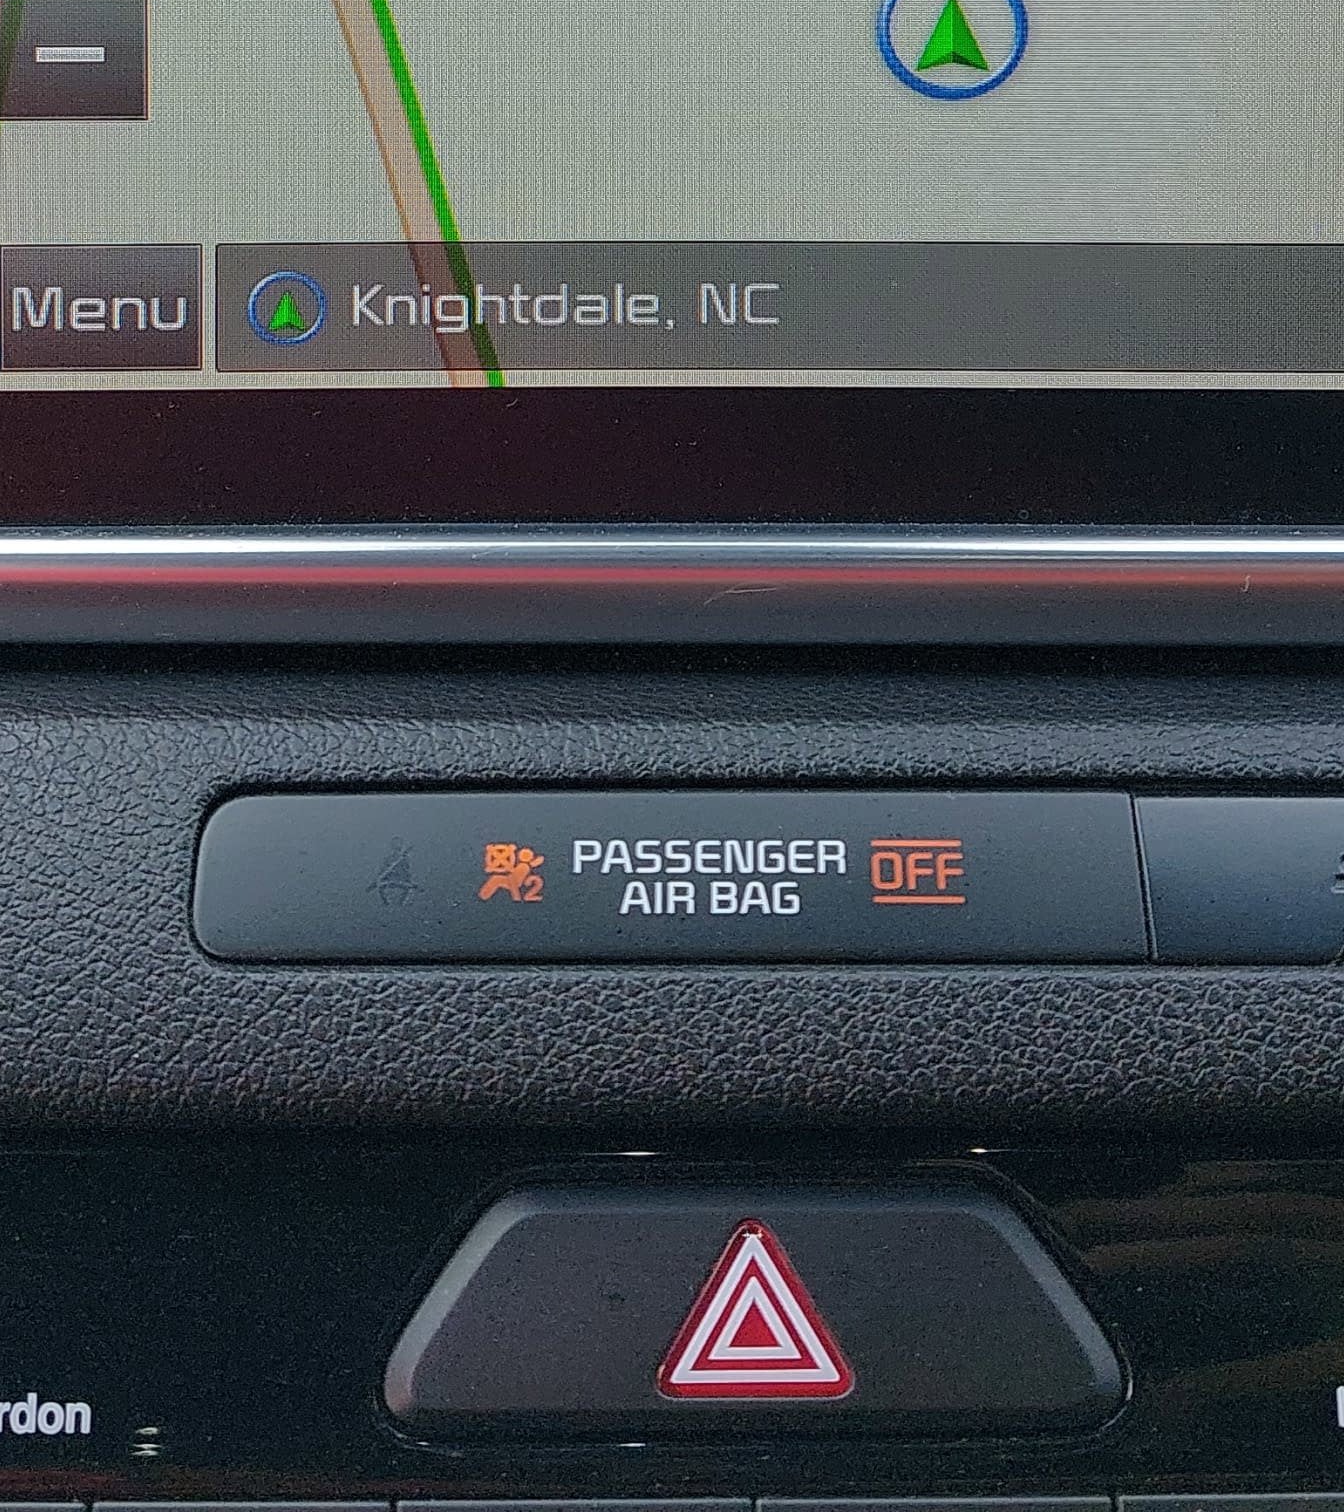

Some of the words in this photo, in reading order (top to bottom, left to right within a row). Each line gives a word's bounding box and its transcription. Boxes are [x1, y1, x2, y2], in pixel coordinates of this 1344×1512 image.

[11, 287, 187, 333] Menu
[352, 284, 676, 333] Knightdale,
[699, 282, 780, 327] NC
[571, 838, 846, 876] PASSENGER
[870, 851, 963, 890] OFF
[619, 881, 697, 914] AIR
[708, 882, 800, 915] BAG
